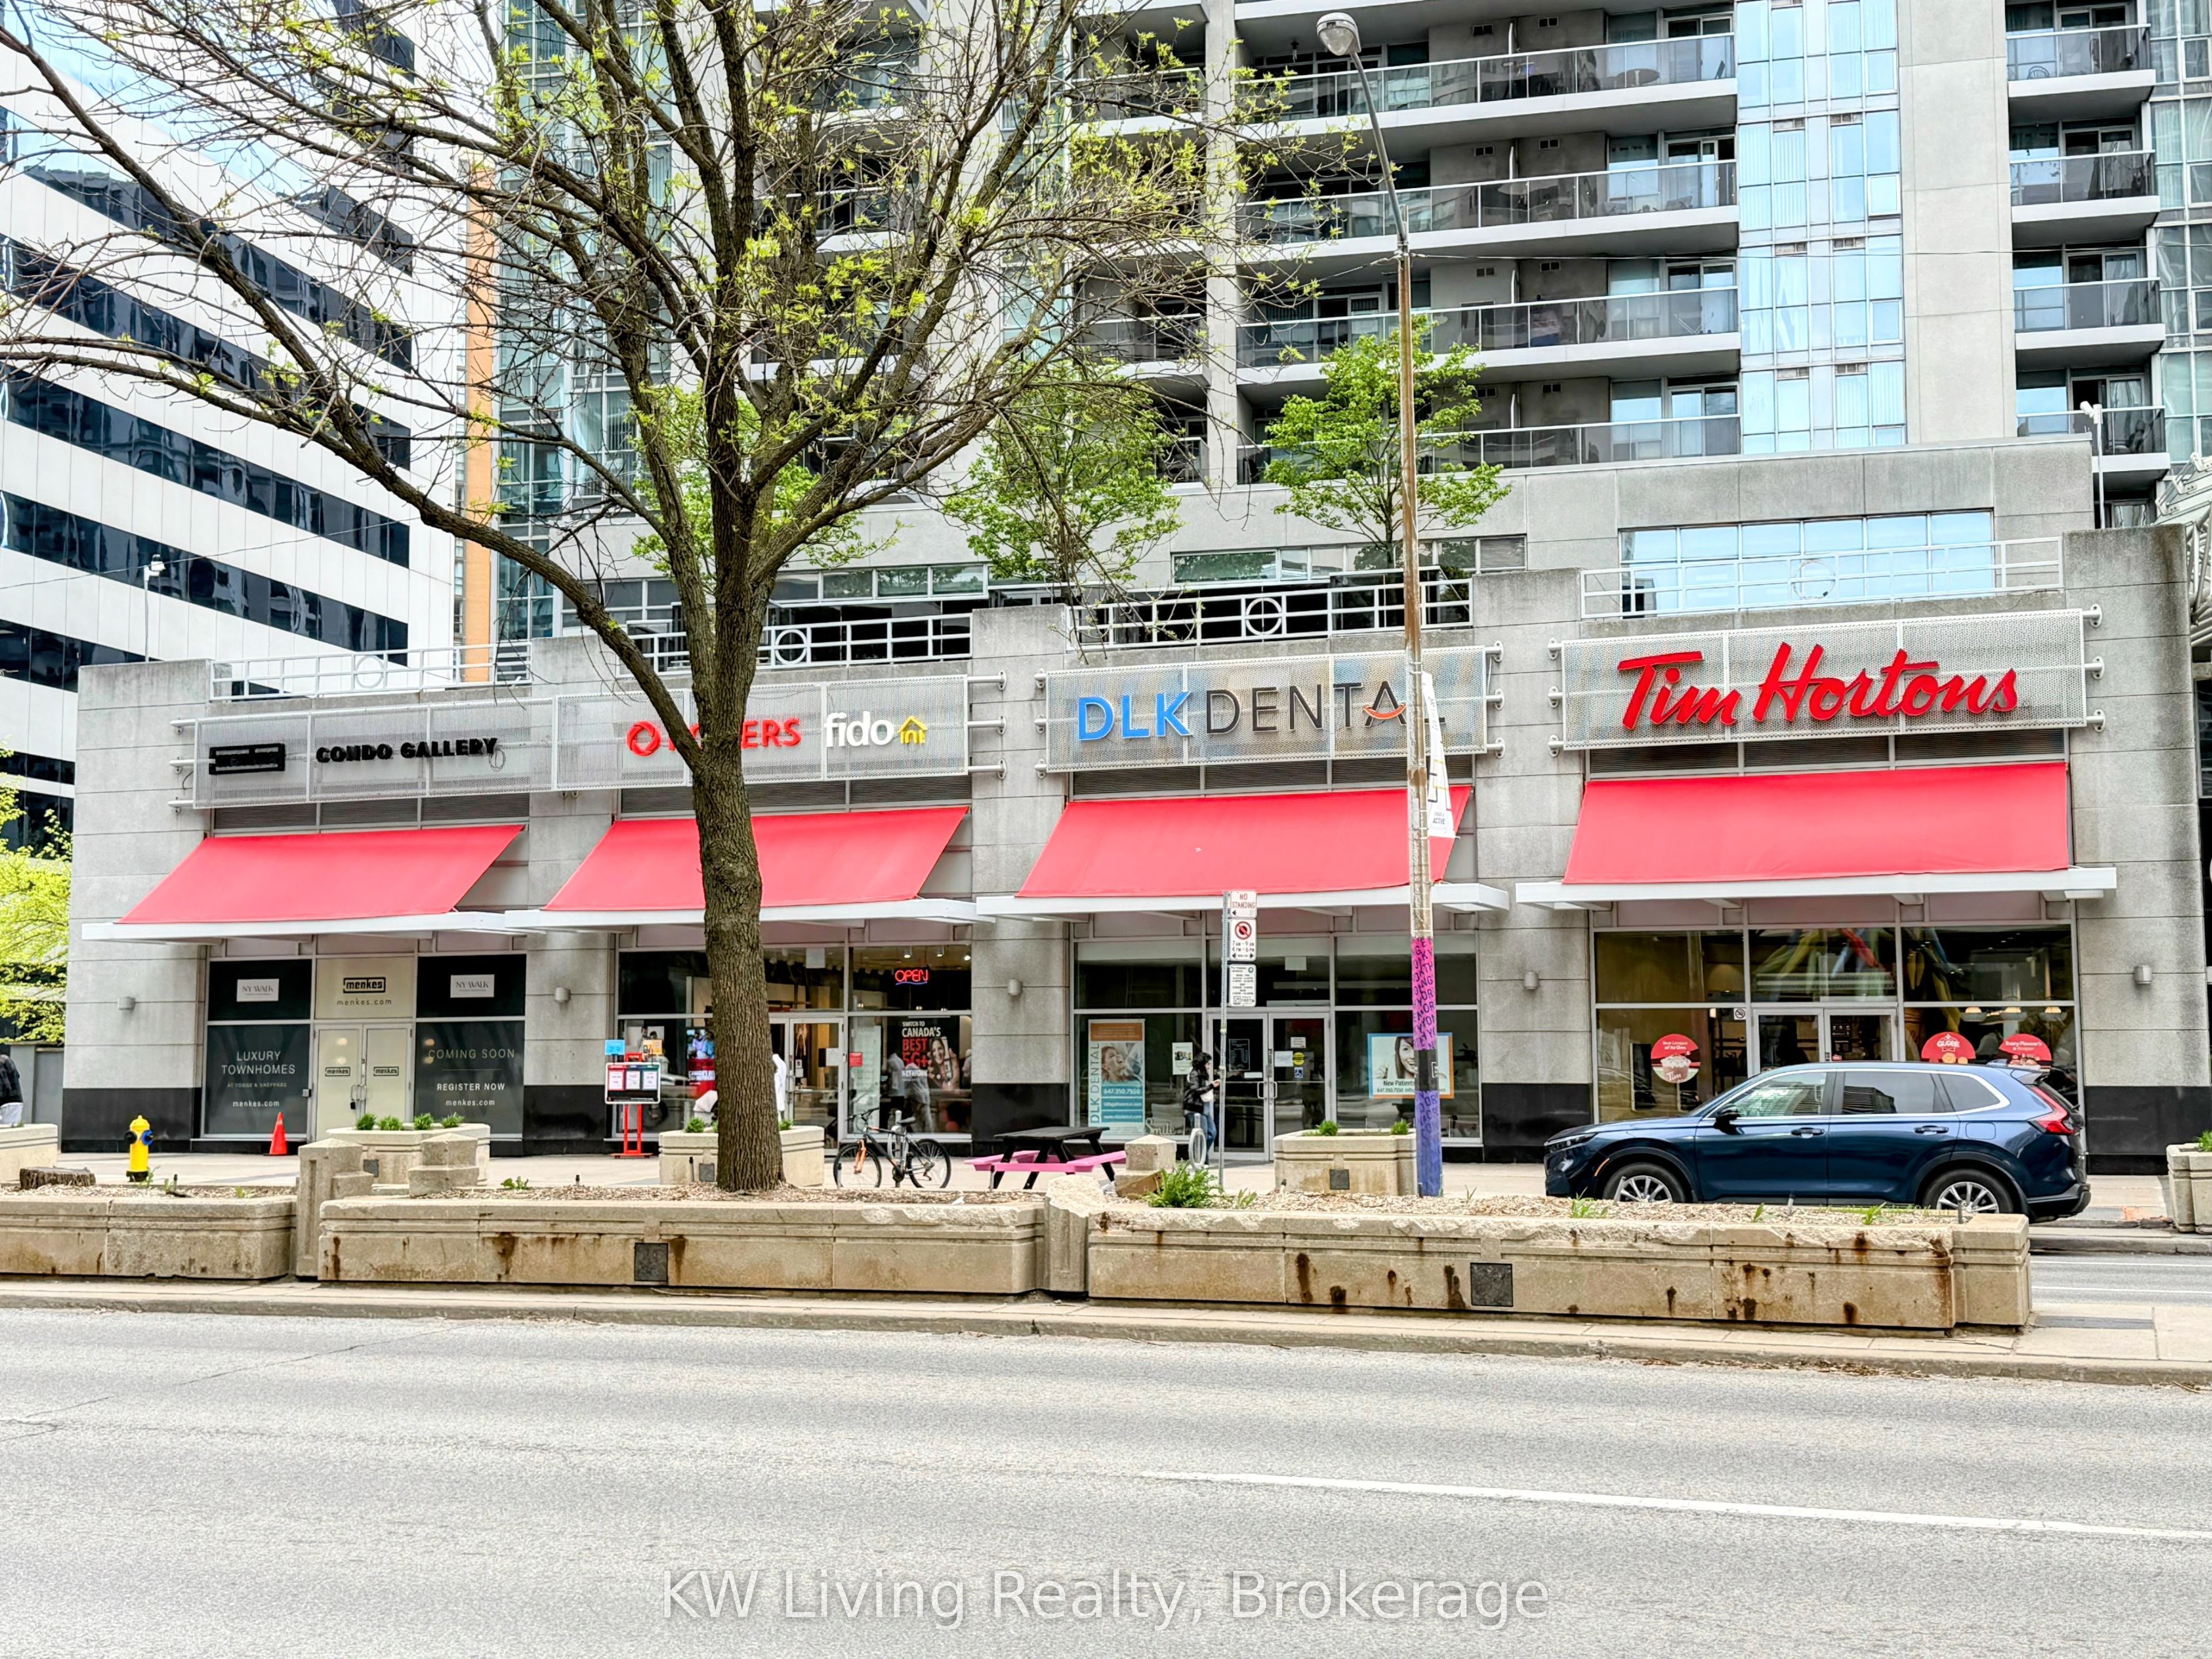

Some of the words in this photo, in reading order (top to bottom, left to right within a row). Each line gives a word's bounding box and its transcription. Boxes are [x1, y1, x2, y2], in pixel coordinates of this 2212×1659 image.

[1617, 650, 1741, 730] Tim
[1752, 642, 2017, 723] Hortons
[1078, 691, 1192, 741] DLK
[824, 711, 895, 748] fido
[316, 744, 393, 763] CONDO
[400, 737, 498, 758] GALLERY
[895, 969, 928, 982] OPEN
[346, 979, 382, 989] menkes
[902, 1027, 941, 1037] CANADA'S
[903, 1039, 927, 1051] BEST
[237, 1051, 281, 1061] LUXURY
[429, 1048, 476, 1059] COMING
[482, 1048, 514, 1059] SOON
[221, 1064, 296, 1074] TOWNHOMES
[1090, 1043, 1100, 1093] DENTAL
[437, 1083, 480, 1091] REGISTER
[1090, 1098, 1100, 1123] DLK
